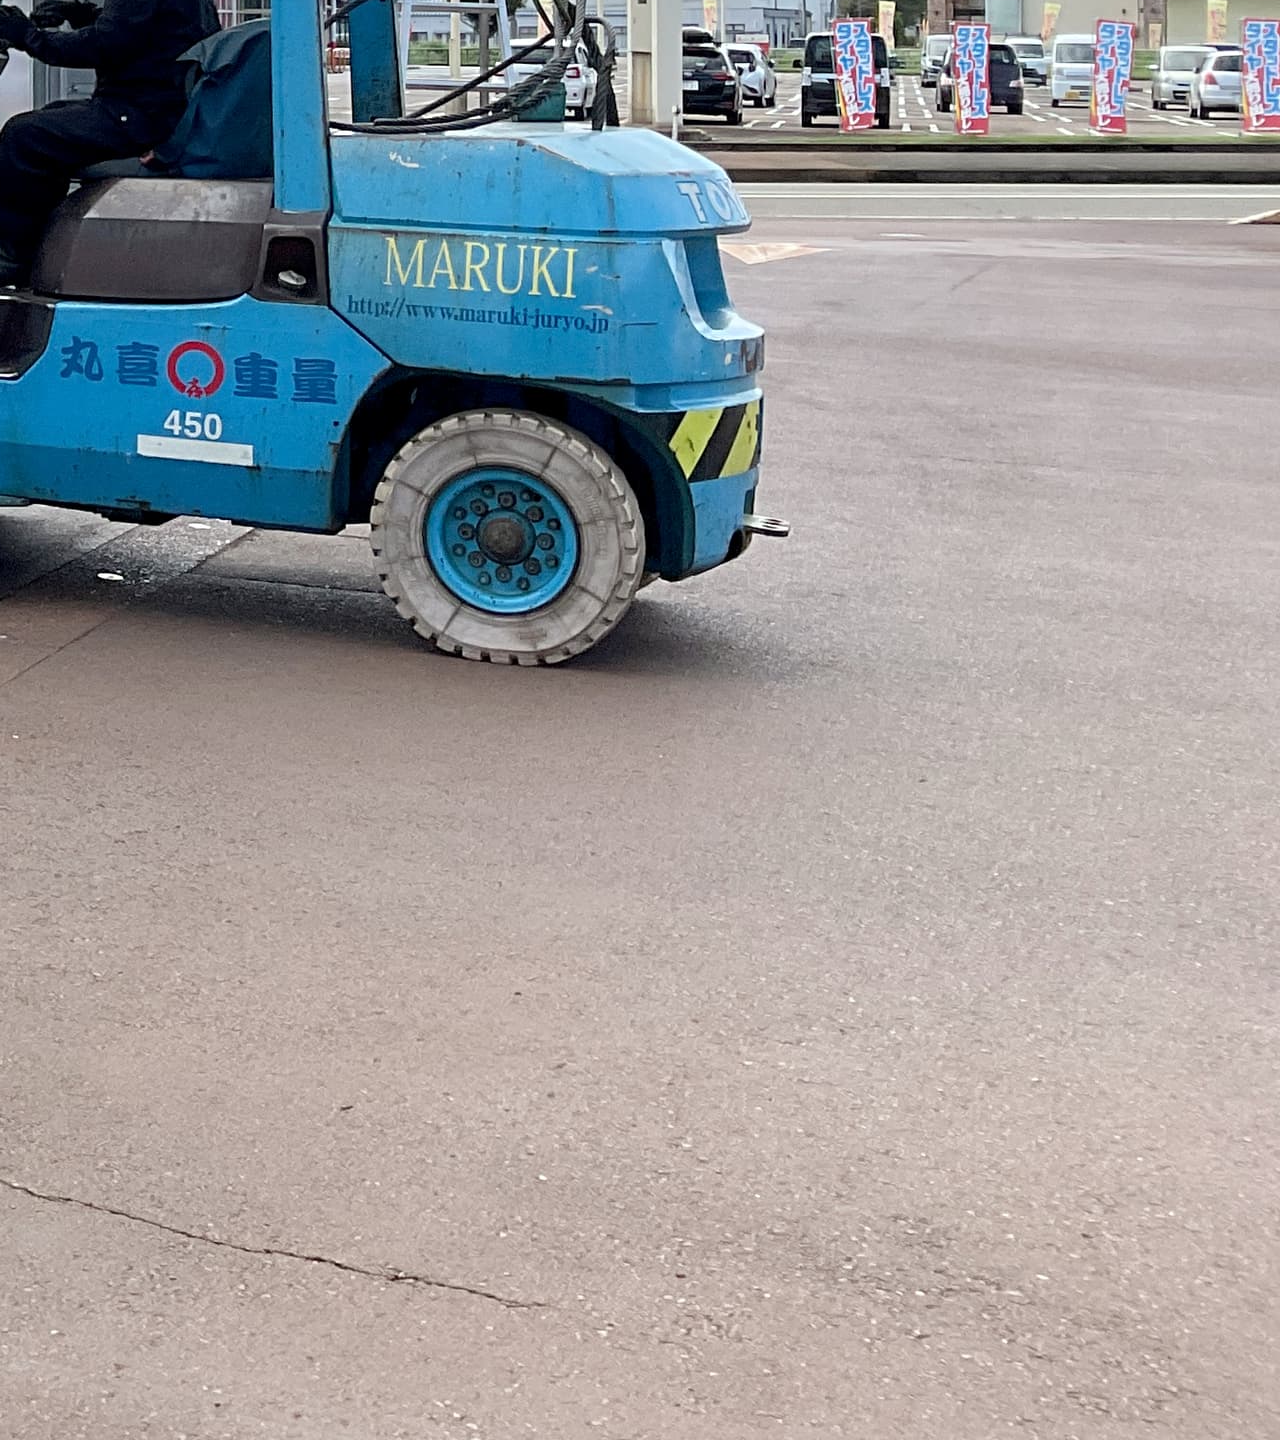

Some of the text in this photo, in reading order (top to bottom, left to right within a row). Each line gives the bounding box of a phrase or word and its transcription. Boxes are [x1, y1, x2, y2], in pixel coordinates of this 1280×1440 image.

[383, 234, 578, 299] MARUKI
[347, 294, 609, 333] http://www.maruki-juryo.jp
[163, 409, 223, 441] 450
